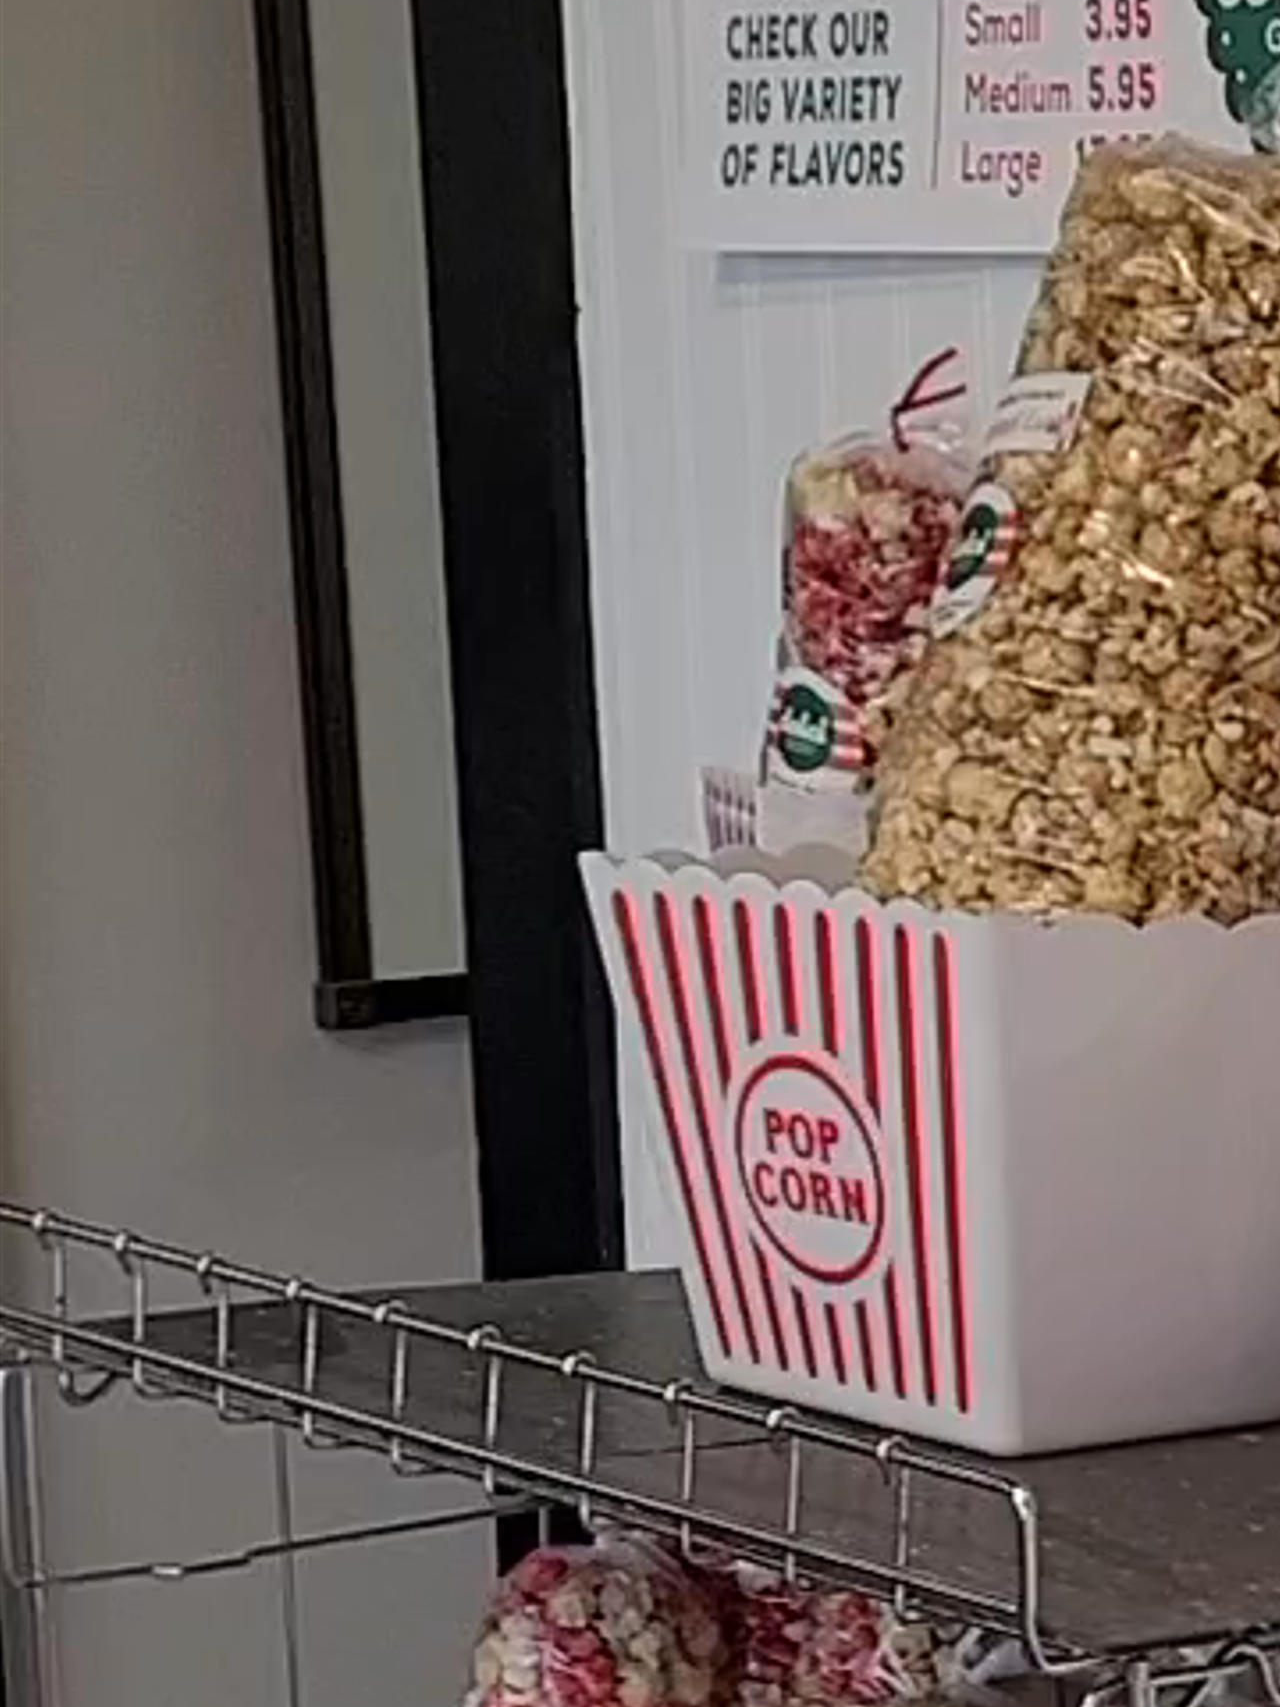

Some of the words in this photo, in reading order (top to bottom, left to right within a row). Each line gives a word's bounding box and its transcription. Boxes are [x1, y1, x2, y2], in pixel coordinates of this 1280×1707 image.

[726, 13, 817, 60] CHECK
[829, 11, 890, 56] OUR
[965, 2, 1041, 46] Small
[726, 80, 771, 123] BIG
[782, 75, 902, 122] VARIETY
[965, 71, 1070, 114] Medium
[1087, 64, 1156, 111] 5.95
[722, 144, 759, 187] OF
[770, 140, 904, 187] FLAVORS
[961, 141, 1041, 198] Large
[763, 1108, 838, 1164] POP
[754, 1161, 870, 1225] CORN
